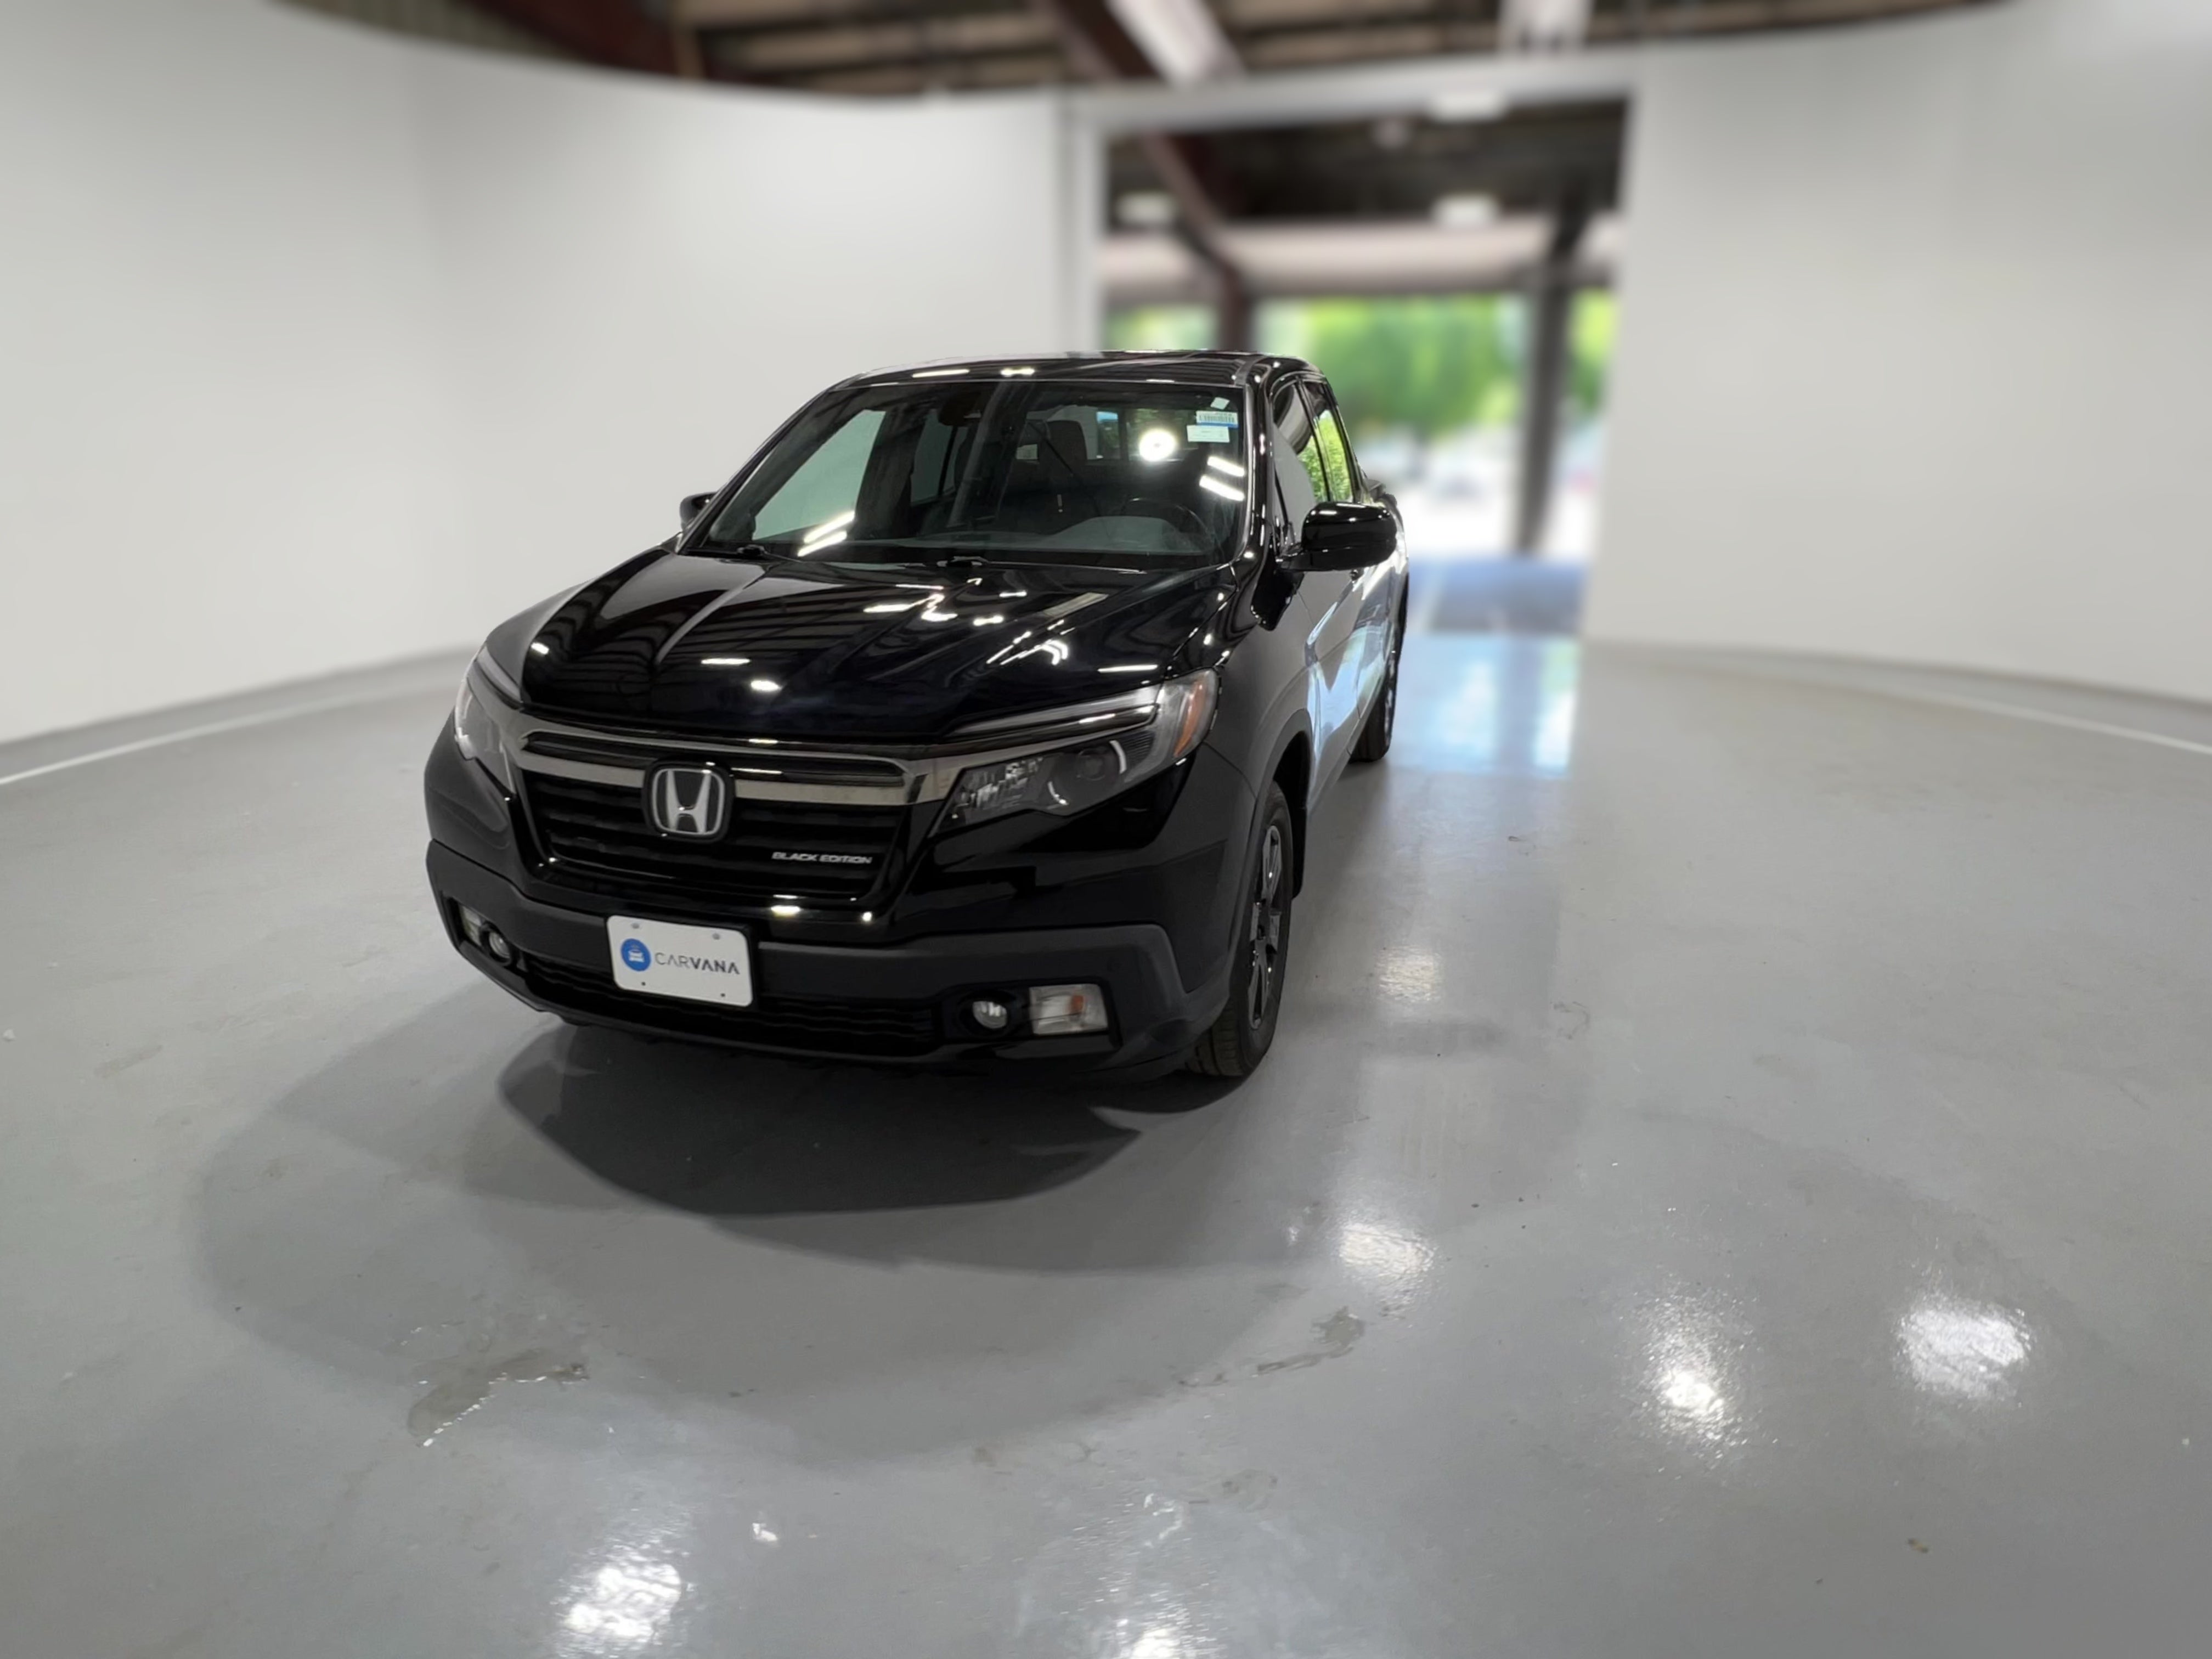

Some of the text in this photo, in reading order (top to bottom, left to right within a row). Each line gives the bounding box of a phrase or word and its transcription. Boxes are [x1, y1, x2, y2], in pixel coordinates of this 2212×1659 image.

[771, 851, 873, 864] BLACK EDITION
[654, 952, 740, 974] CARVANA
